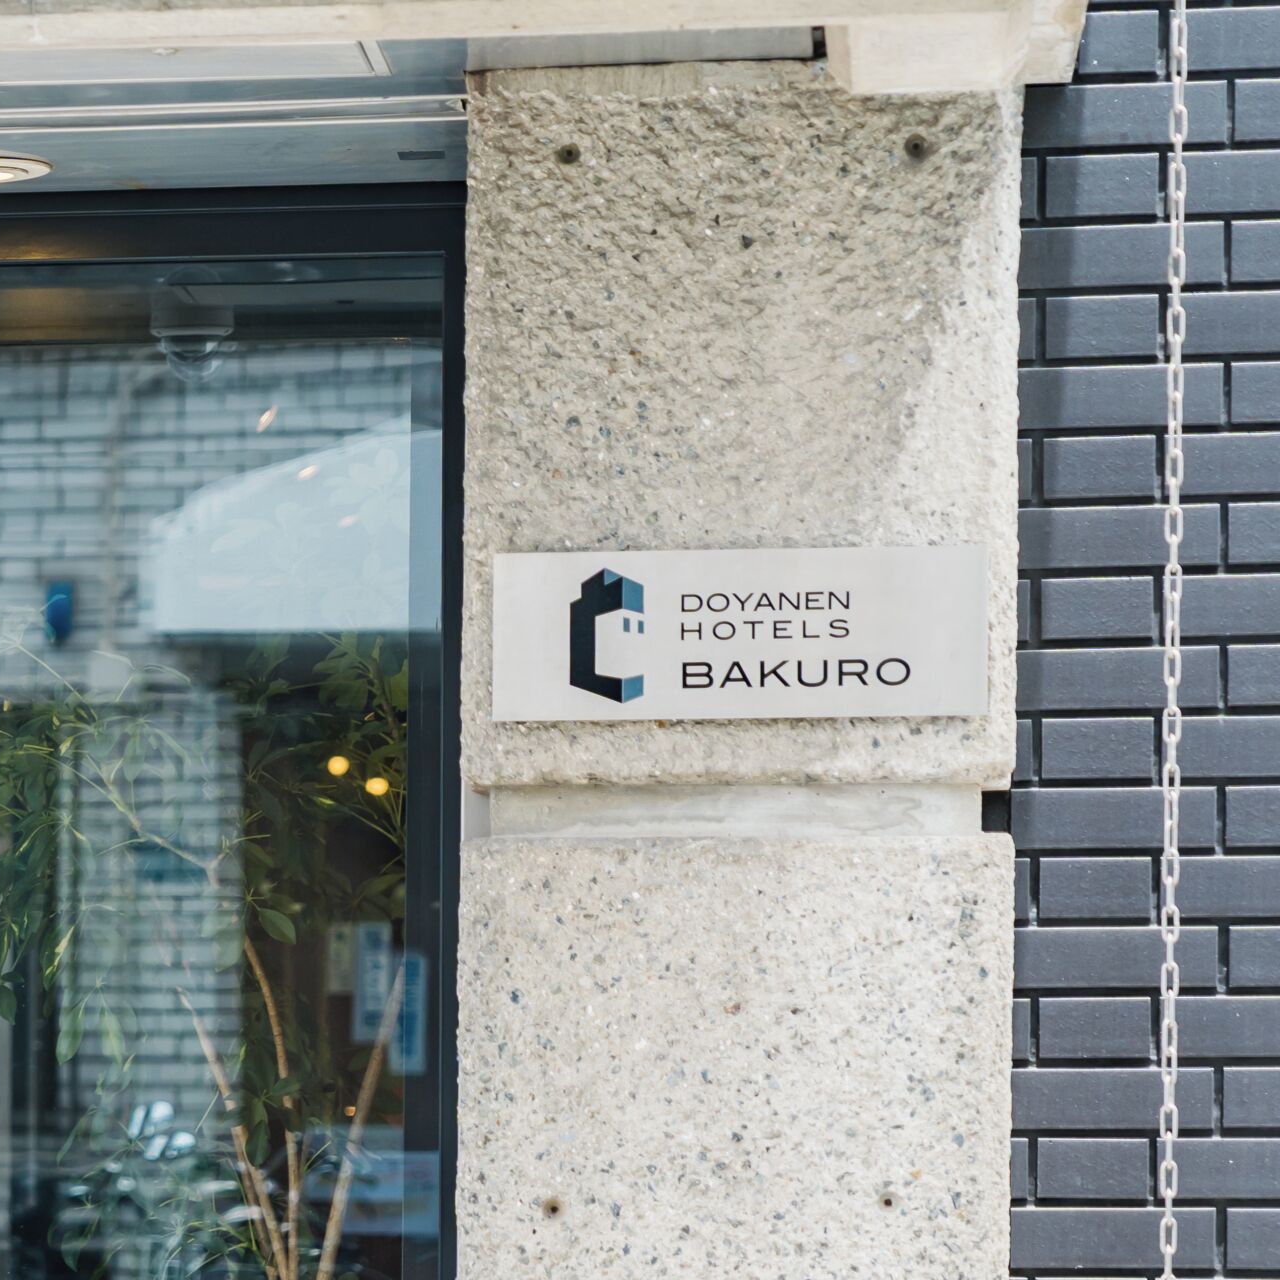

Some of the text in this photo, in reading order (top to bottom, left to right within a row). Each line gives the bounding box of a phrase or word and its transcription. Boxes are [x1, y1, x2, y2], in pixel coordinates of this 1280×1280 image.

[680, 590, 850, 613] DOYANEN
[680, 618, 850, 641] HOTELS
[681, 657, 912, 690] BAKURO
